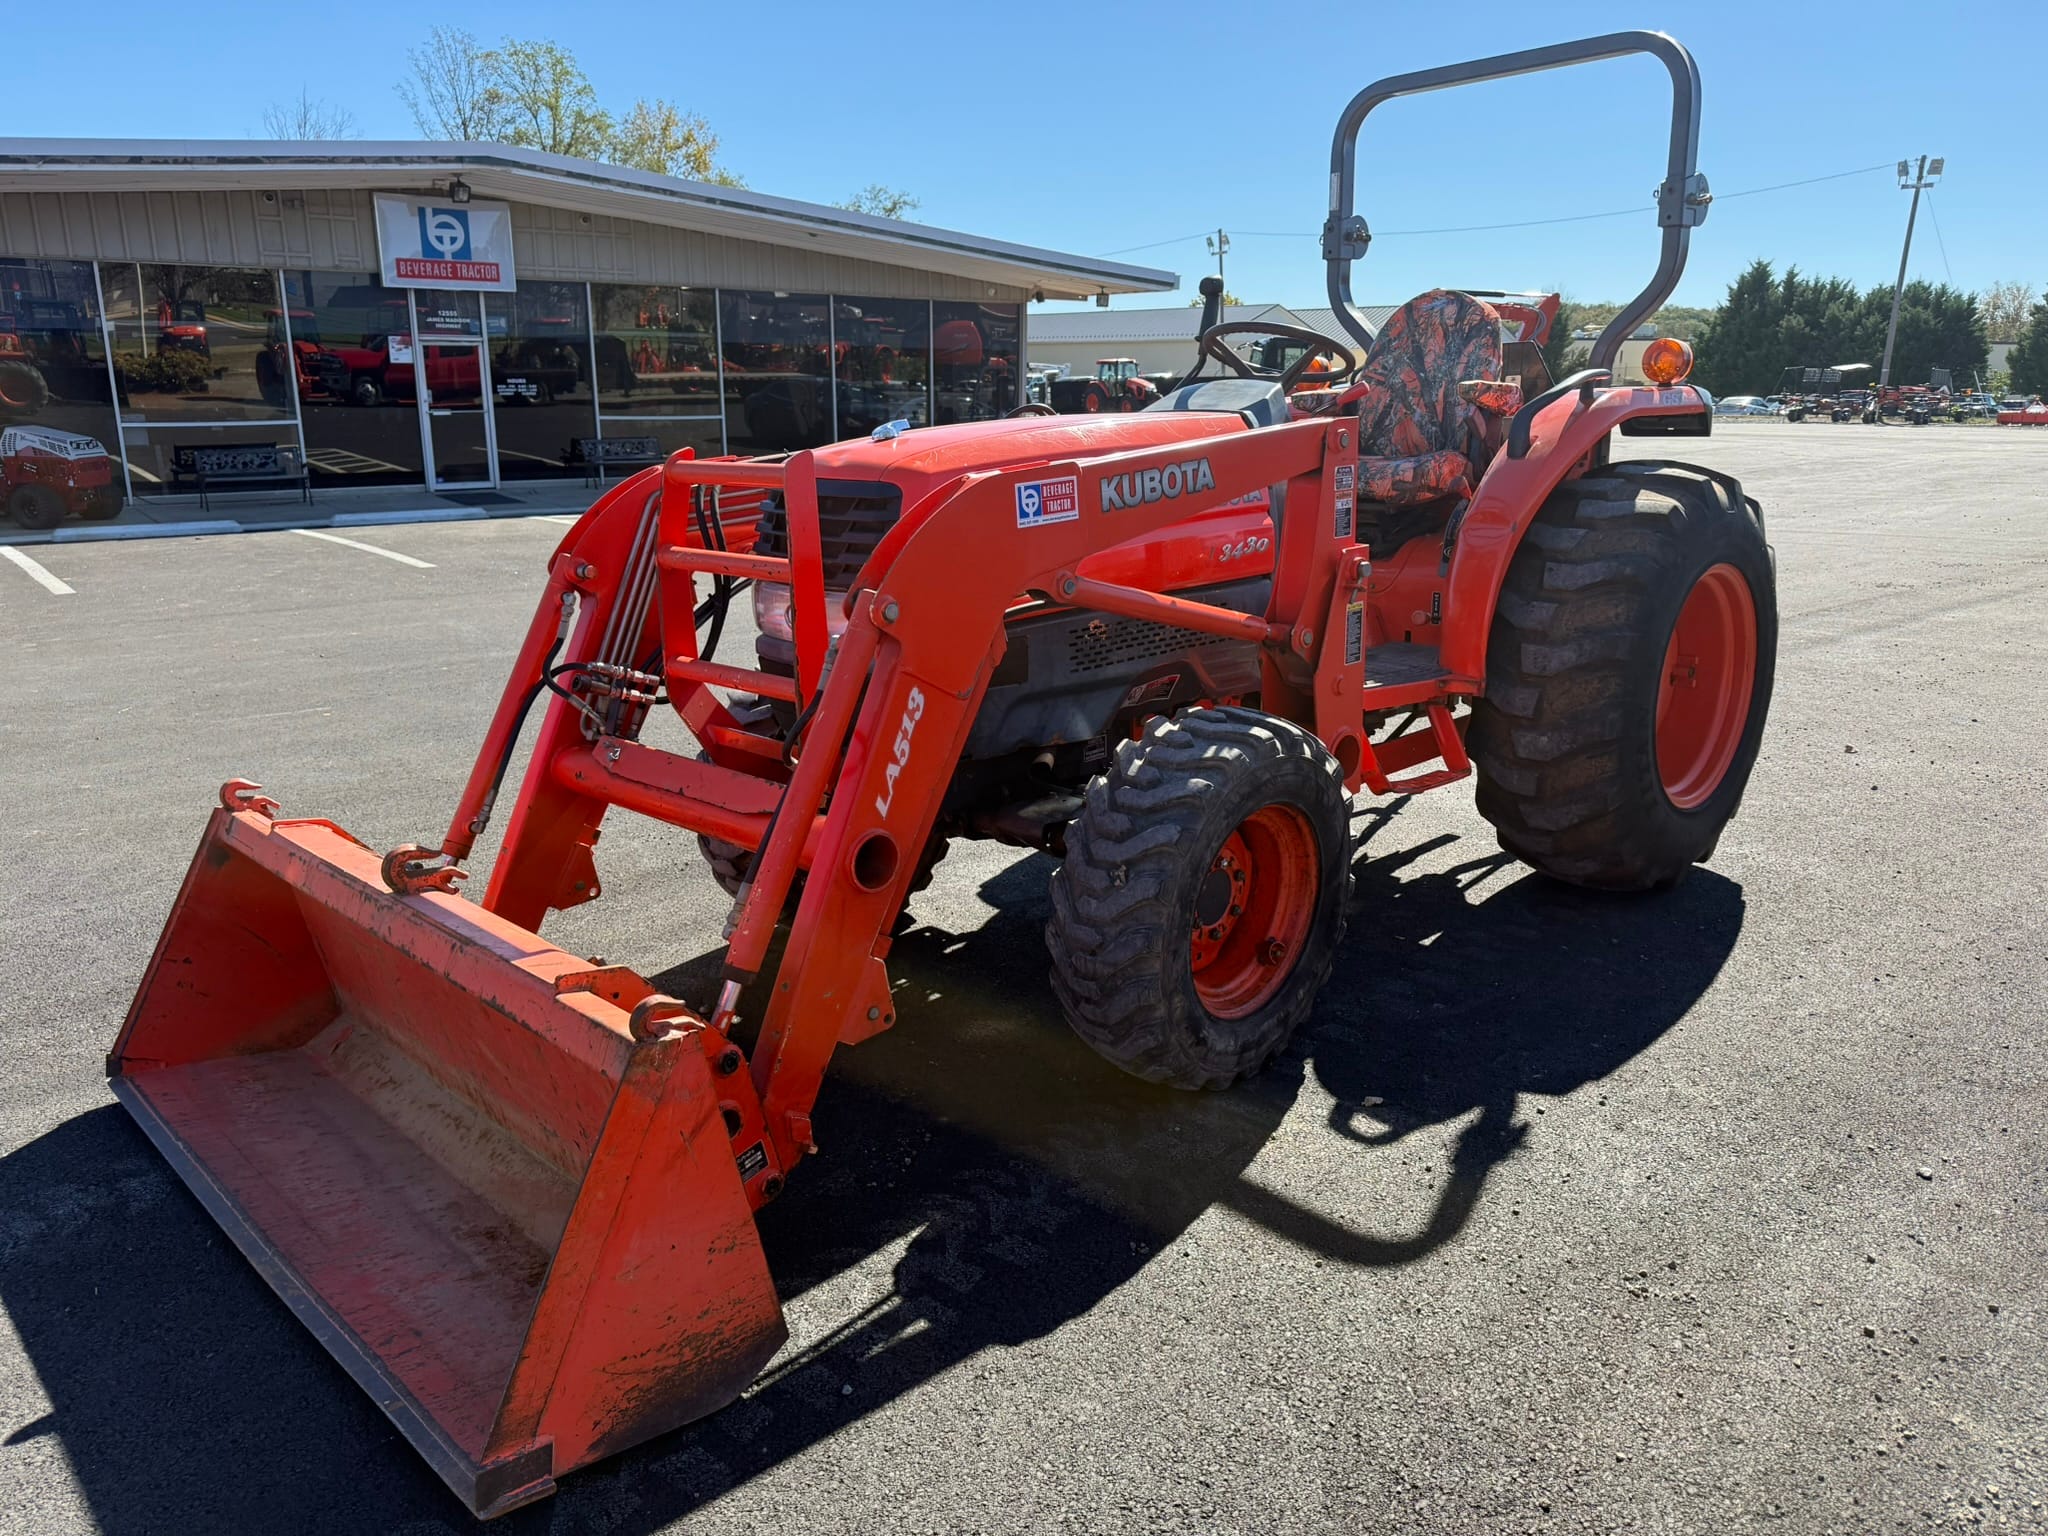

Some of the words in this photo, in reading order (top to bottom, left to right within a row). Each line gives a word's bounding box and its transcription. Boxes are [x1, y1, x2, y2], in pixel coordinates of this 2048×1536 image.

[399, 261, 453, 277] BEVERAGE
[456, 263, 498, 280] TRACTOR
[1043, 482, 1074, 498] BEVERAGE
[1100, 457, 1216, 513] KUBOTA
[1046, 498, 1072, 513] TRACTOR
[1218, 535, 1270, 562] 3430
[875, 686, 926, 821] LA513
